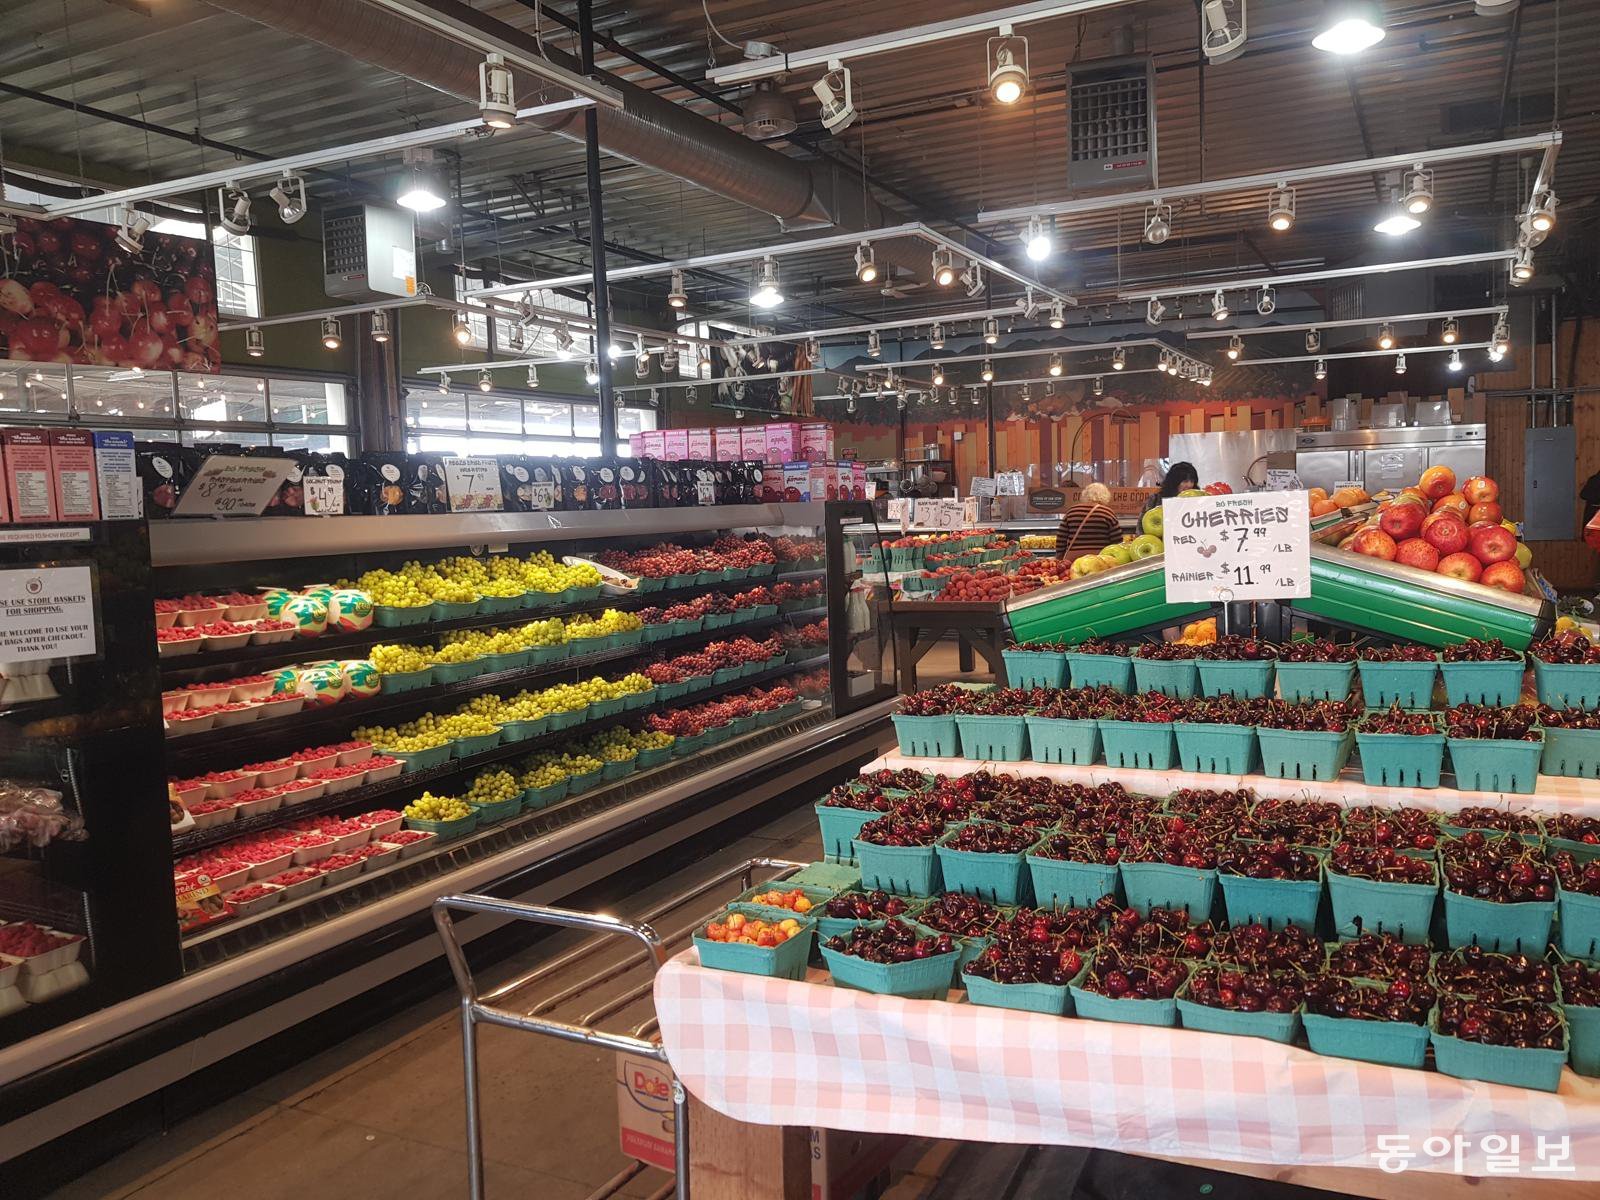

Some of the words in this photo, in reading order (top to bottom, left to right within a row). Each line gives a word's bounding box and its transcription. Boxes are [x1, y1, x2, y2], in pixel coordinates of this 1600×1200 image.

[1181, 506, 1288, 528] CHERRIES
[1172, 534, 1197, 545] RED
[1171, 571, 1214, 582] RAINIER
[53, 595, 86, 603] BASKETS
[6, 607, 21, 615] FOR
[9, 627, 42, 636] WELCOME
[45, 626, 54, 634] TO
[55, 625, 69, 633] USE
[70, 624, 88, 632] YOUR
[4, 637, 23, 646] BAGS
[25, 635, 46, 644] AFTER
[17, 643, 40, 653] THANK
[634, 1071, 669, 1097] Dole
